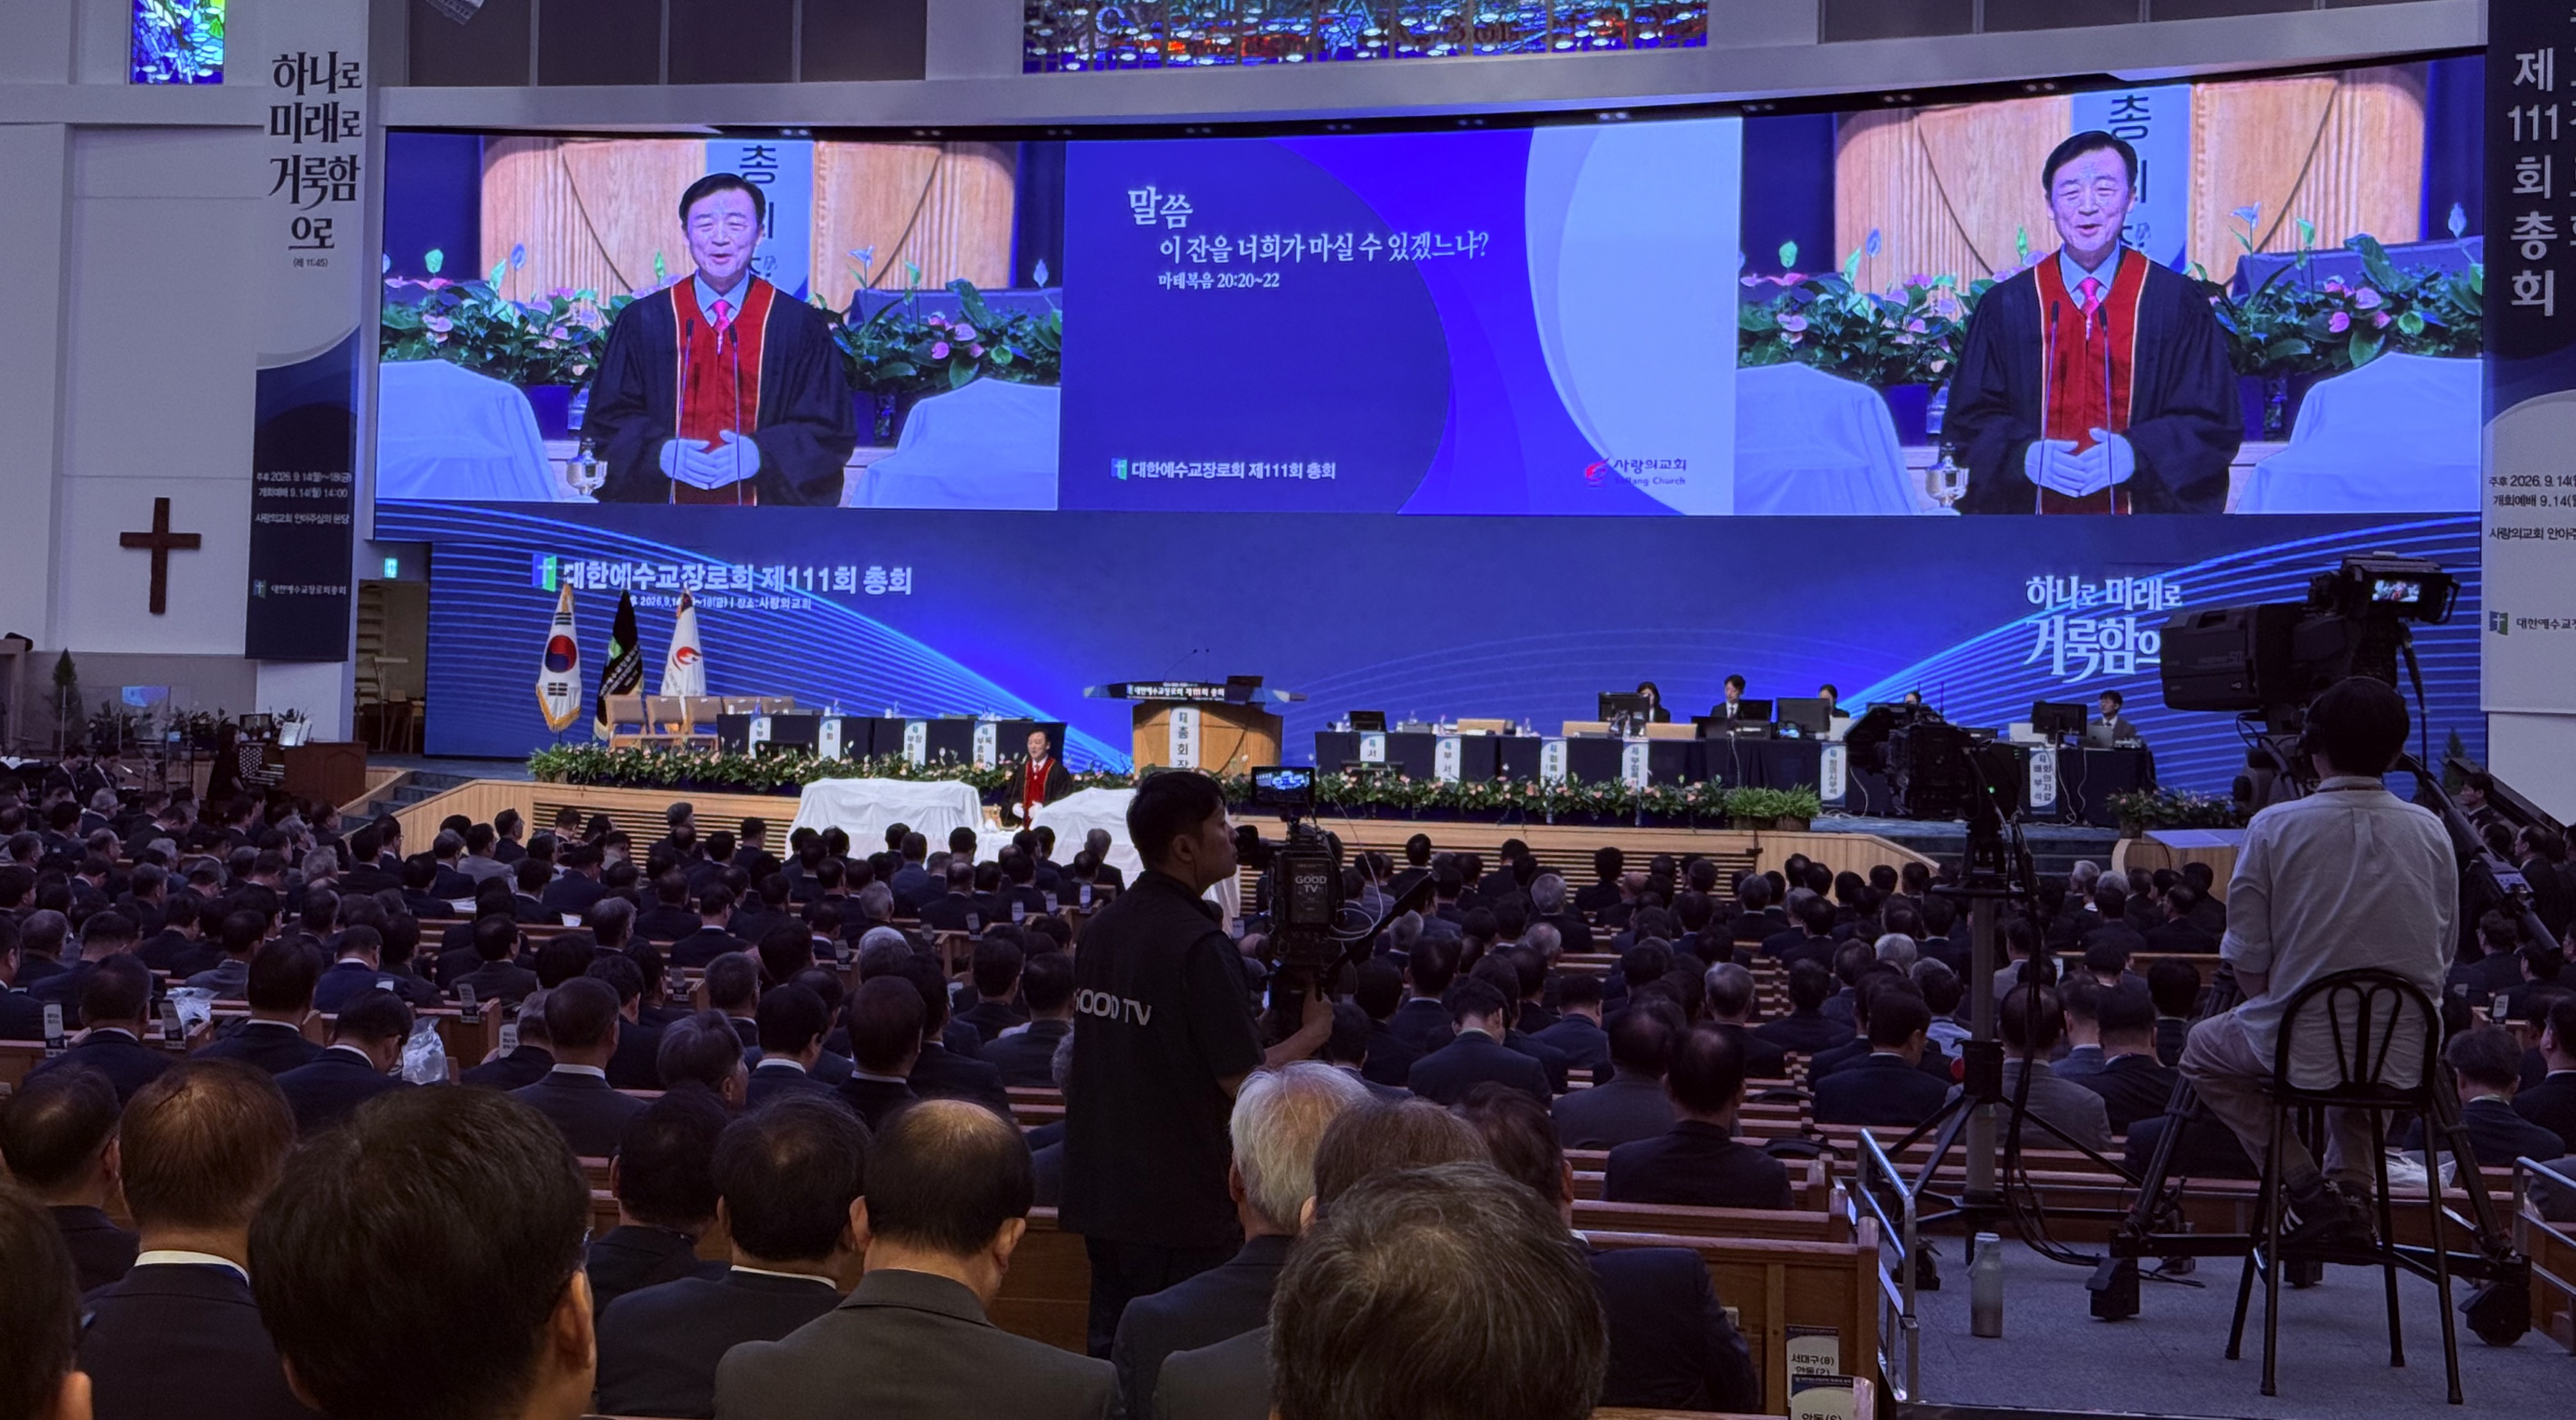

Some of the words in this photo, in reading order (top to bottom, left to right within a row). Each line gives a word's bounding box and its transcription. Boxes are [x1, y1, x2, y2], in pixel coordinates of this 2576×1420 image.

[272, 51, 362, 95] 하나로
[270, 102, 362, 143] 미래로
[268, 154, 361, 210] 거룩함
[1128, 185, 1193, 229] 말씀
[288, 216, 335, 250] 으로
[1159, 235, 1181, 264] 이
[1186, 235, 1233, 264] 잔을
[1237, 233, 1305, 264] 너희가
[1309, 233, 1354, 262] 마실
[1358, 235, 1383, 262] 수
[1387, 230, 1490, 262] 있겠느냐?
[2511, 210, 2558, 317] 총회
[1157, 272, 1215, 290] 마태복음
[1217, 272, 1280, 288] 20:20~22
[1131, 461, 1245, 479] 대한예수교장로회
[1248, 462, 1303, 480] 제111회
[1306, 462, 1336, 480] 총회
[1613, 458, 1687, 475] 사랑의교회
[1652, 477, 1686, 485] Church
[2489, 476, 2508, 487] 주후
[2493, 494, 2536, 507] 개회예배
[2489, 527, 2544, 540] 사랑의교회
[564, 561, 754, 592] 대한예수교장로회
[761, 565, 857, 594] 제111회
[863, 565, 912, 596] 총회
[2025, 575, 2098, 611] 하나로
[2104, 576, 2182, 611] 미래로
[2023, 615, 2161, 683] 거룩함으
[1294, 876, 1327, 884] GOOD
[1303, 884, 1318, 893] TV
[1123, 998, 1152, 1025] TV
[1792, 1353, 1834, 1366] 서대구(8)
